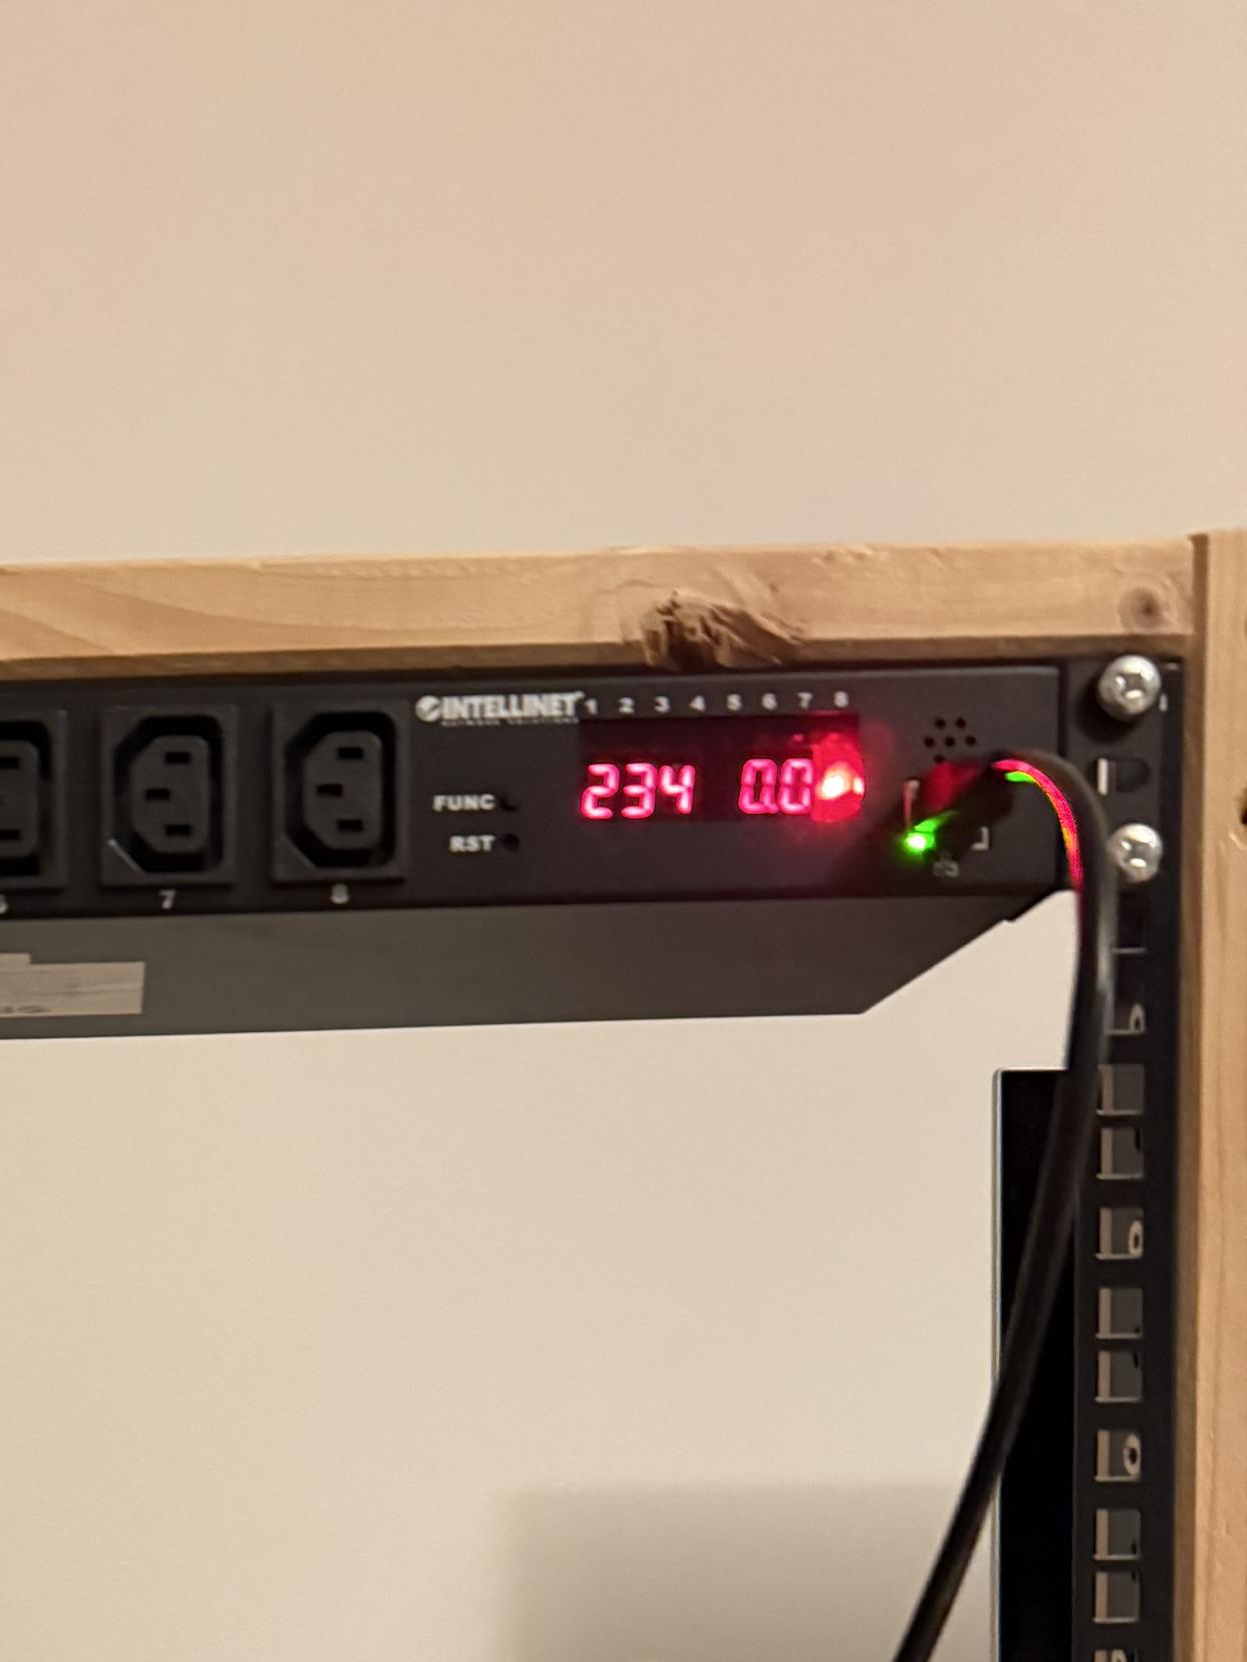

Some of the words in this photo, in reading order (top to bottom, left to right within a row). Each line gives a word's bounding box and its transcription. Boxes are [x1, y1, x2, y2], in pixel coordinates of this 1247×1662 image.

[440, 691, 583, 720] INTELLINET
[584, 699, 598, 715] 1
[618, 697, 635, 714] 2
[654, 696, 671, 713] 3
[689, 696, 707, 711] 4
[726, 693, 743, 711] 5
[761, 693, 778, 711] 6
[798, 691, 813, 709] 7
[833, 690, 850, 708] 8
[432, 793, 496, 812] FUNC
[580, 763, 696, 819] 234
[449, 835, 495, 852] RST
[158, 889, 176, 909] 7
[331, 883, 350, 904] 8
